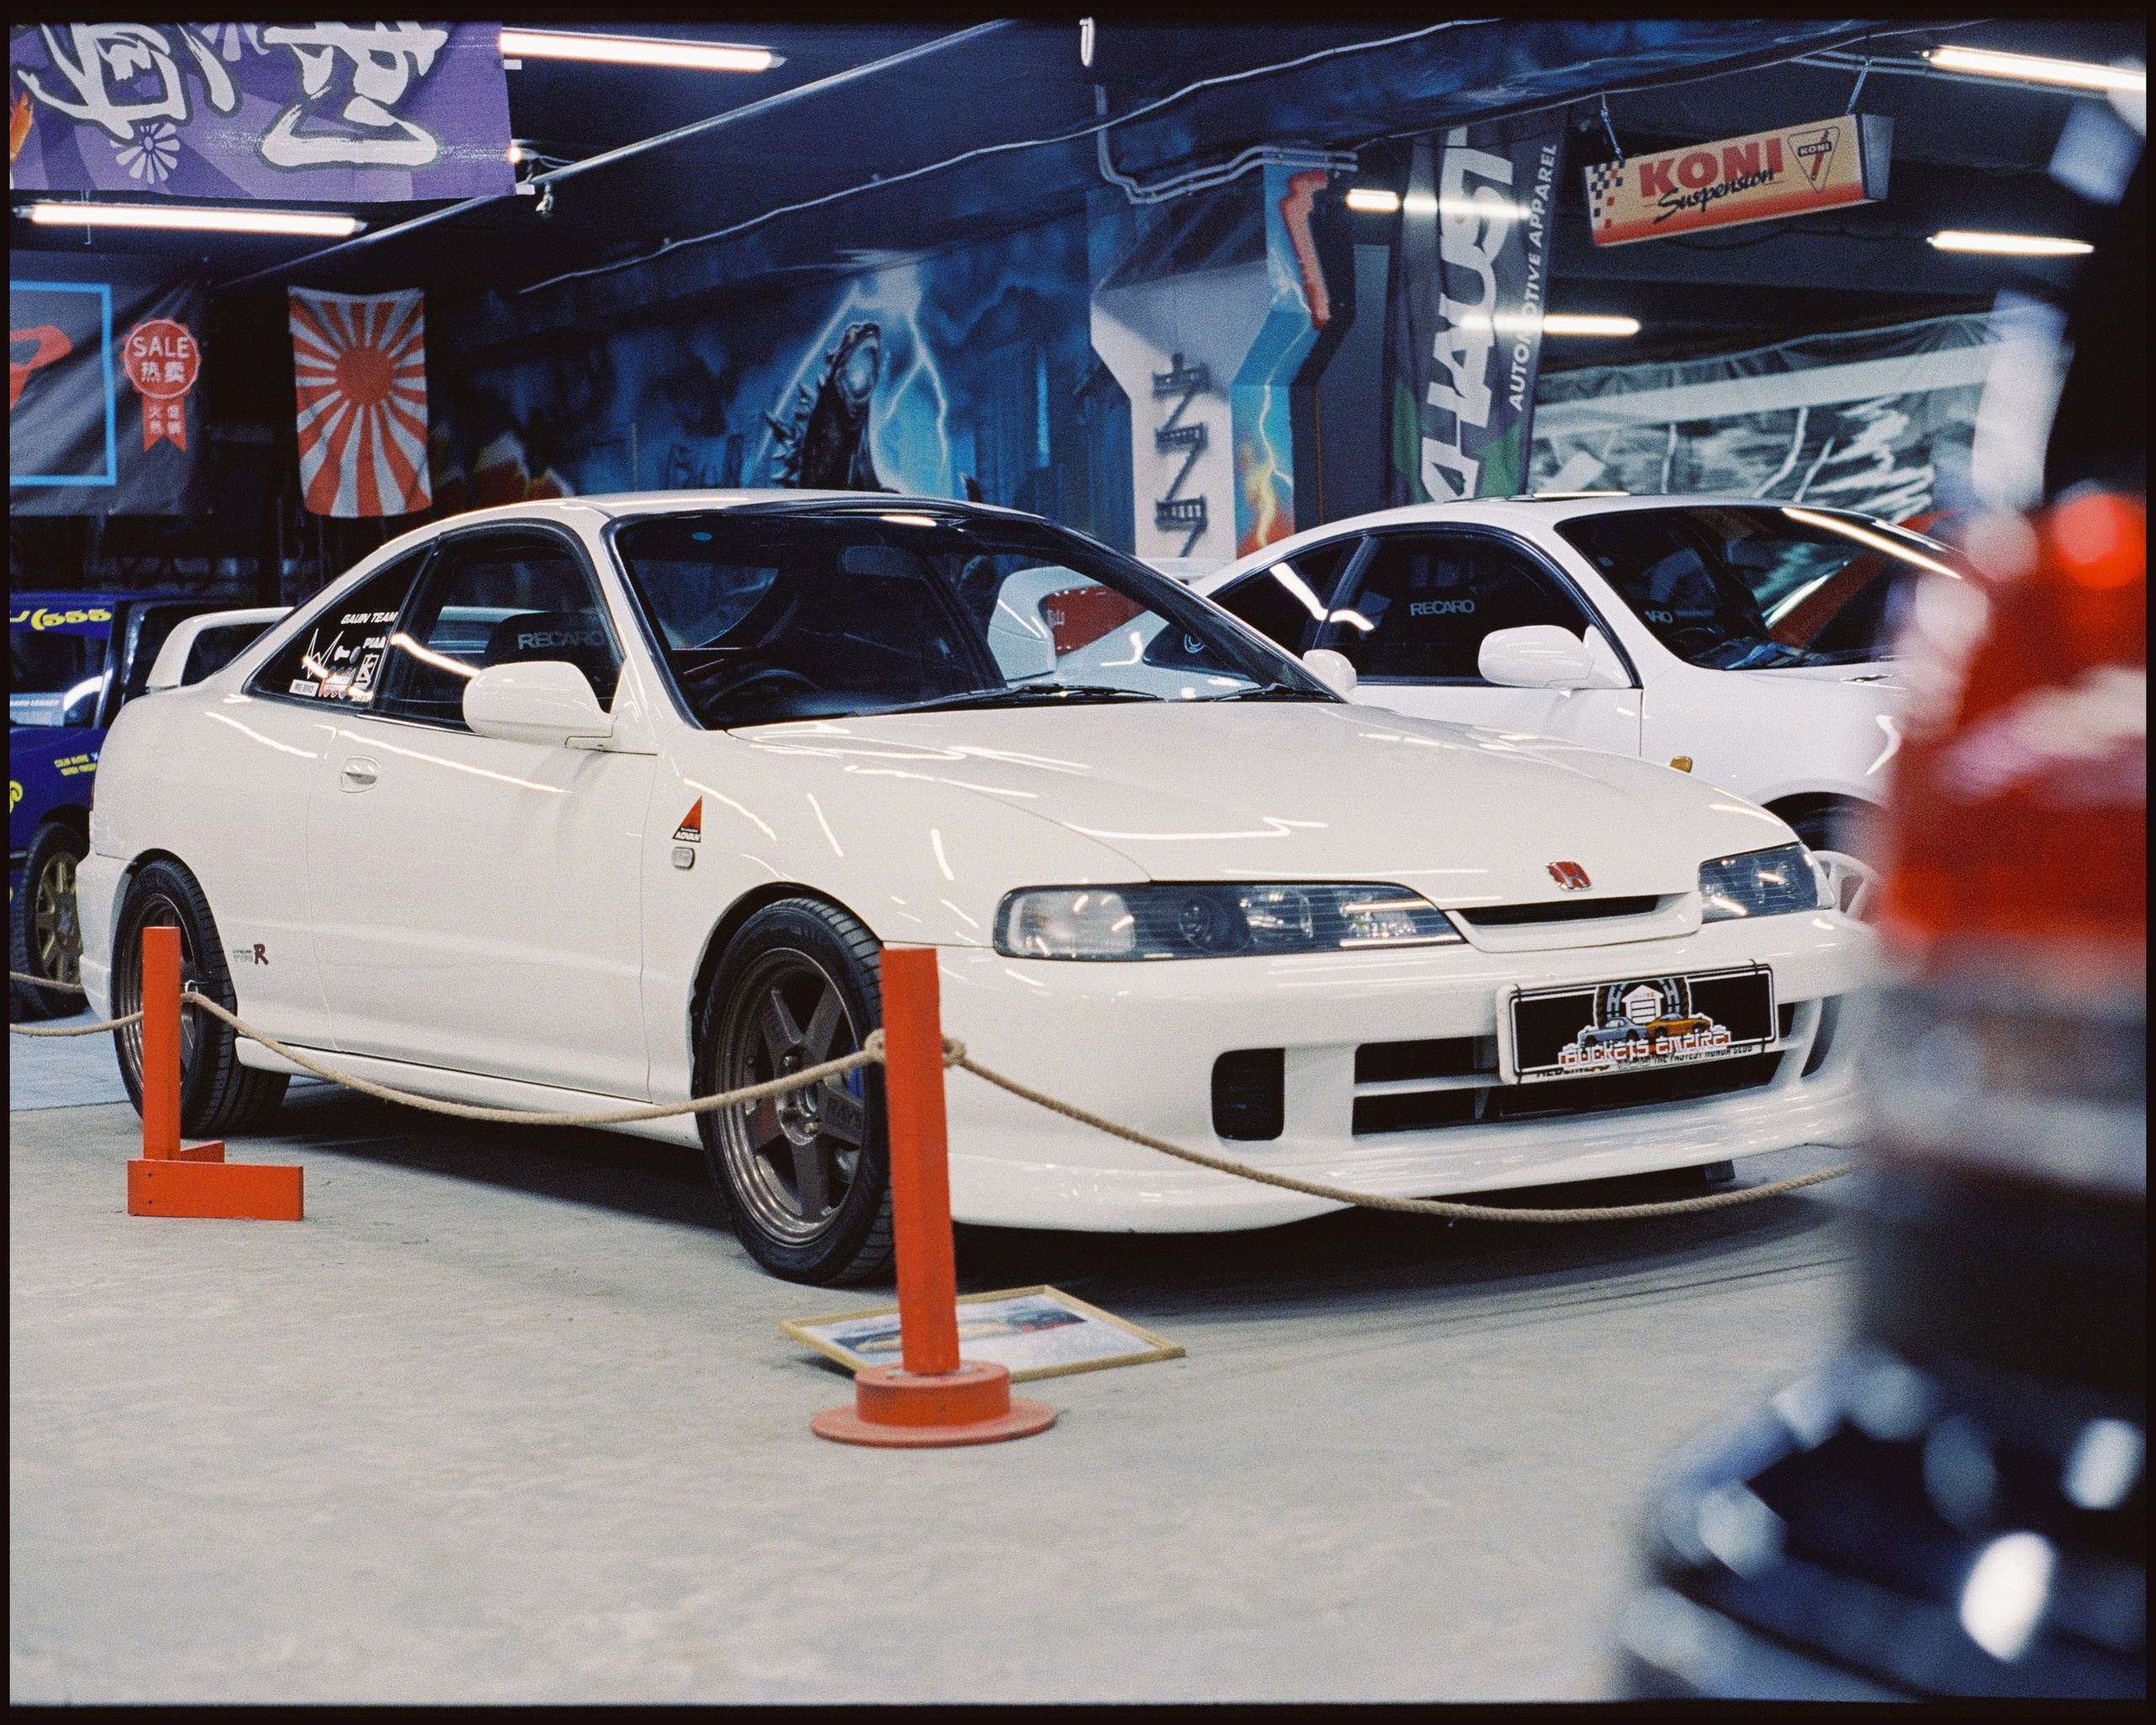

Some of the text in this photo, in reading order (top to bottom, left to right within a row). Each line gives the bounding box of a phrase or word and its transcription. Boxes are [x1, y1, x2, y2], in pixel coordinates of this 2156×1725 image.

[1799, 142, 1829, 155] KONI
[1639, 137, 1784, 197] KONI
[1528, 143, 1557, 249] APPAREL
[1653, 168, 1774, 224] Suspension
[132, 336, 190, 359] SALE
[371, 611, 399, 623] TEAM
[1410, 600, 1475, 617] RECARO
[363, 637, 387, 649] PIAA
[518, 630, 606, 650] RECARO
